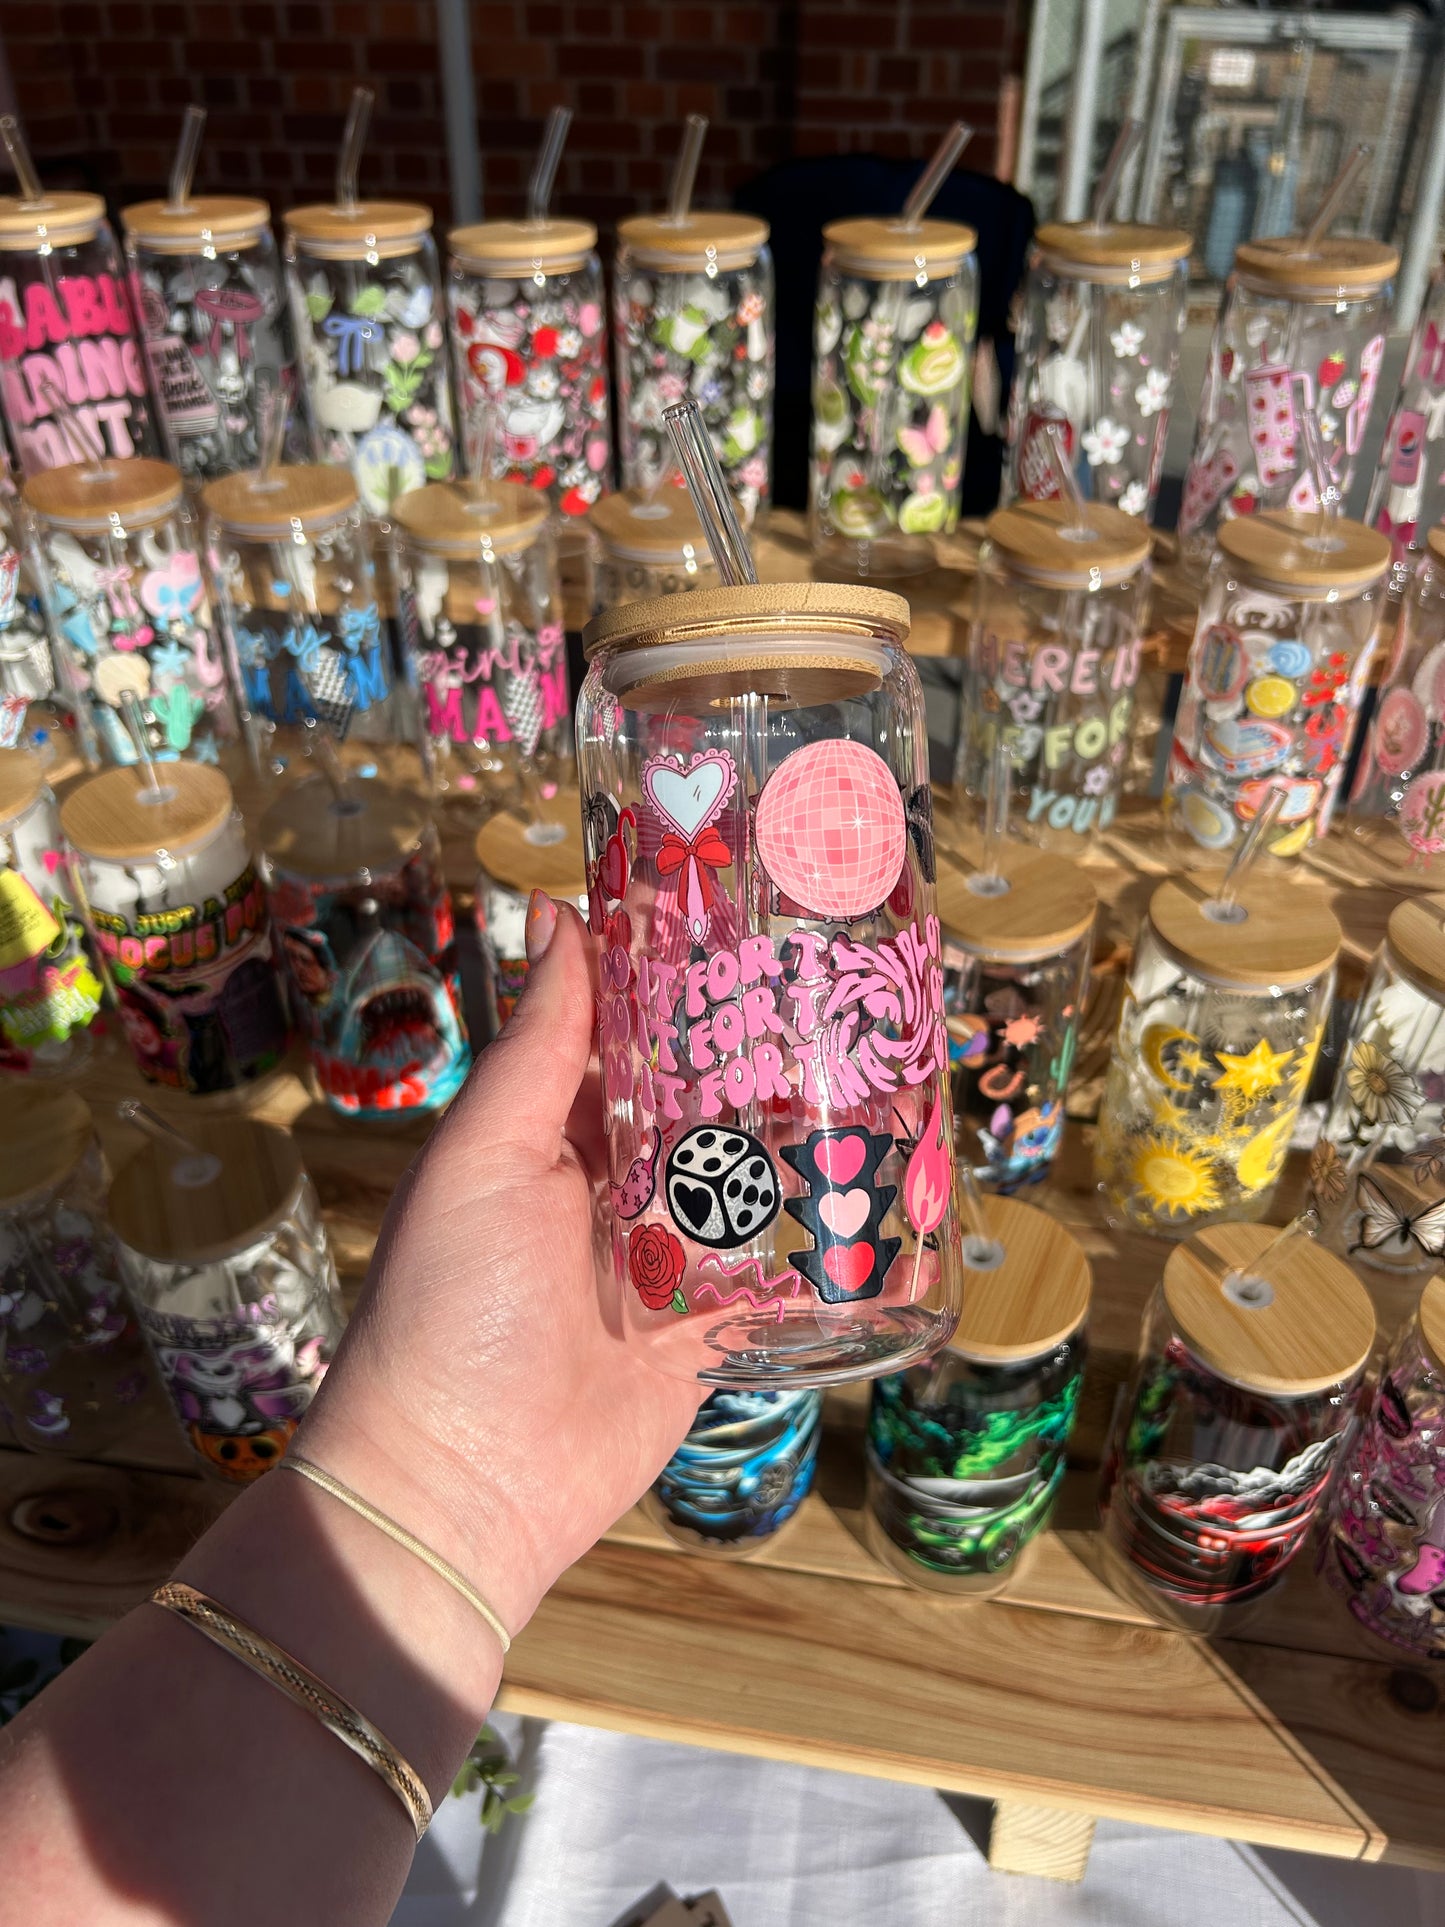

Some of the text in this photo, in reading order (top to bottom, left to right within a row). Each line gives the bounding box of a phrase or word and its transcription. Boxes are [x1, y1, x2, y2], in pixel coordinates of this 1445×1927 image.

[1044, 694, 1132, 769] FOR
[638, 955, 678, 1019] IT
[686, 934, 785, 1018] FOR
[637, 1007, 680, 1073] IT
[689, 986, 785, 1070] FOR
[640, 1061, 688, 1120] IT
[700, 1041, 792, 1118] FOR
